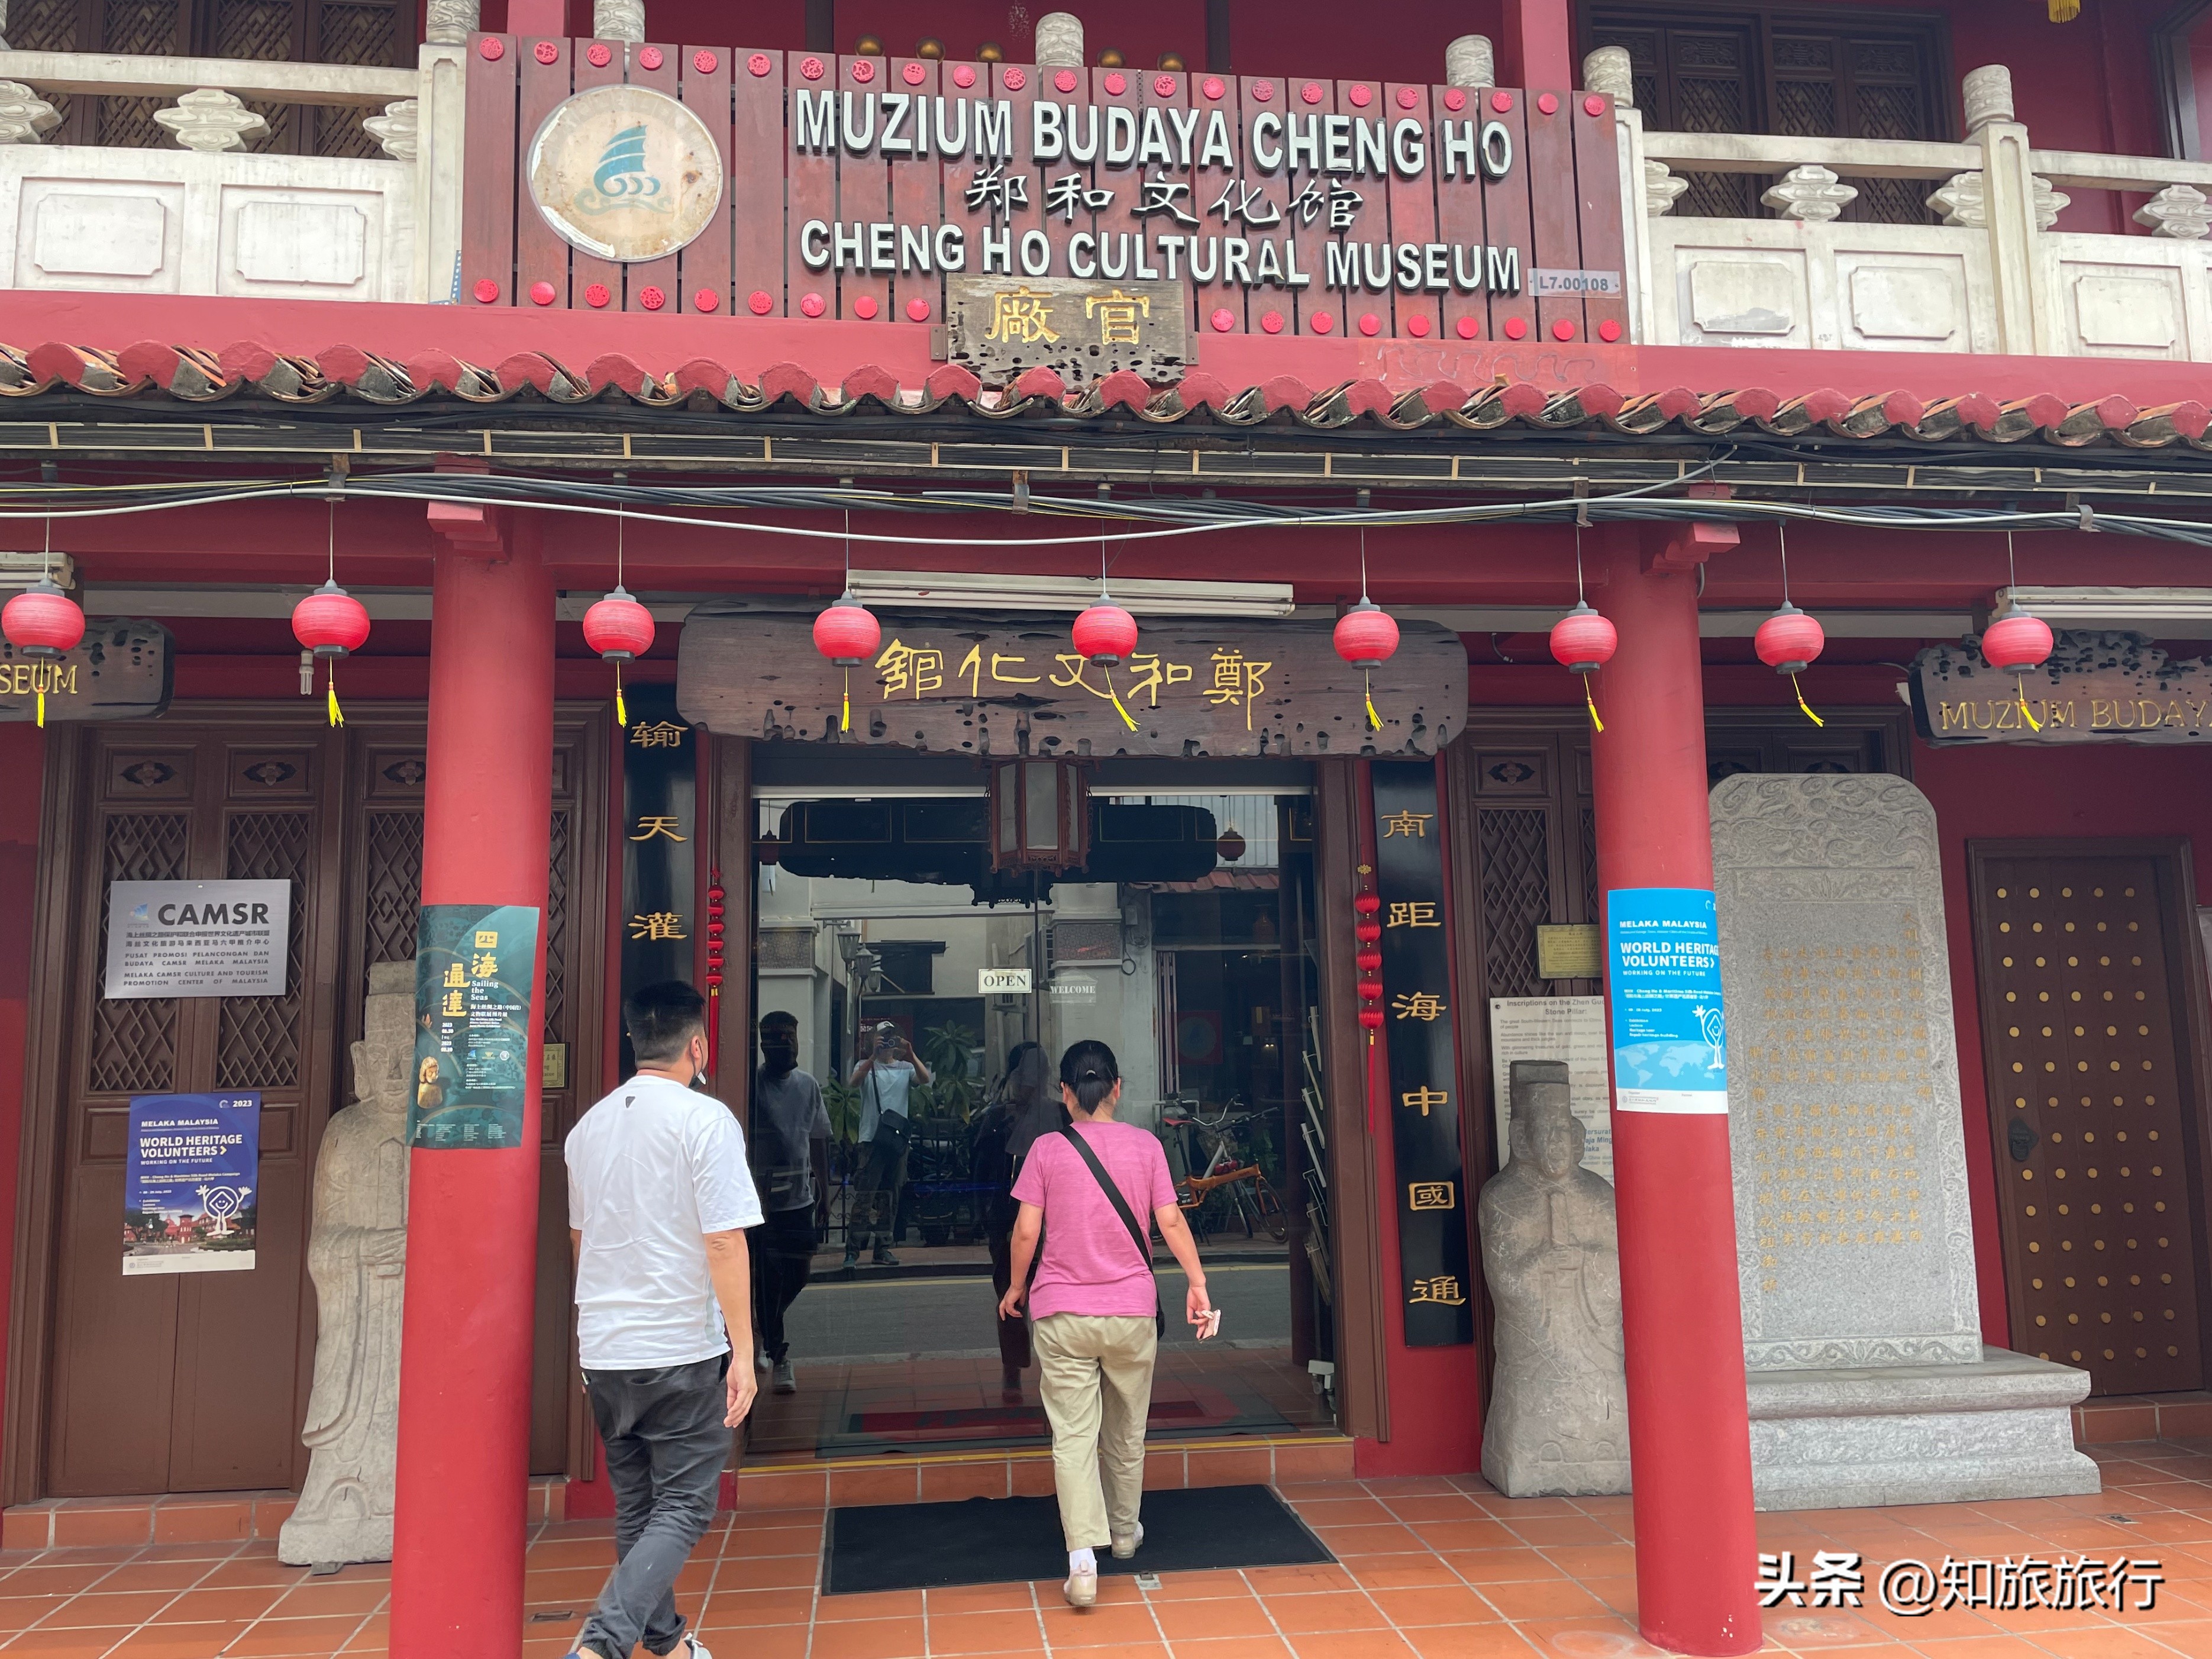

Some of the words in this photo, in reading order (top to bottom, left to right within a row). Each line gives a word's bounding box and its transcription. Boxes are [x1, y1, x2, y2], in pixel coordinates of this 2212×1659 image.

[796, 89, 1012, 161] MUZIUM
[1034, 100, 1233, 169] BUDAYA
[1252, 111, 1425, 176] CHENG
[1443, 119, 1513, 180] HO
[965, 164, 1363, 229] 郑和文化馆
[801, 219, 965, 271] CHENG
[982, 226, 1051, 276] HO
[1068, 231, 1310, 286] CULTURAL
[1326, 241, 1520, 293] MUSEUM
[1539, 276, 1609, 291] L7.00108
[158, 311, 269, 334] CAMSR
[1940, 699, 2078, 730] MUZIUM
[2091, 699, 2212, 728] BUDAY
[1619, 920, 1659, 928] MELAKA
[1662, 920, 1707, 929] MALAYSIA
[1620, 942, 1672, 954] WORLD
[1622, 955, 1709, 968] VOLUNTEERS
[471, 980, 499, 989] Sailing
[983, 975, 1026, 987] OPEN
[1050, 985, 1096, 995] WELCOME
[140, 1137, 183, 1148] WORLD
[186, 1134, 243, 1146] HERITAGE
[141, 1145, 218, 1158] VOLUNTEERS
